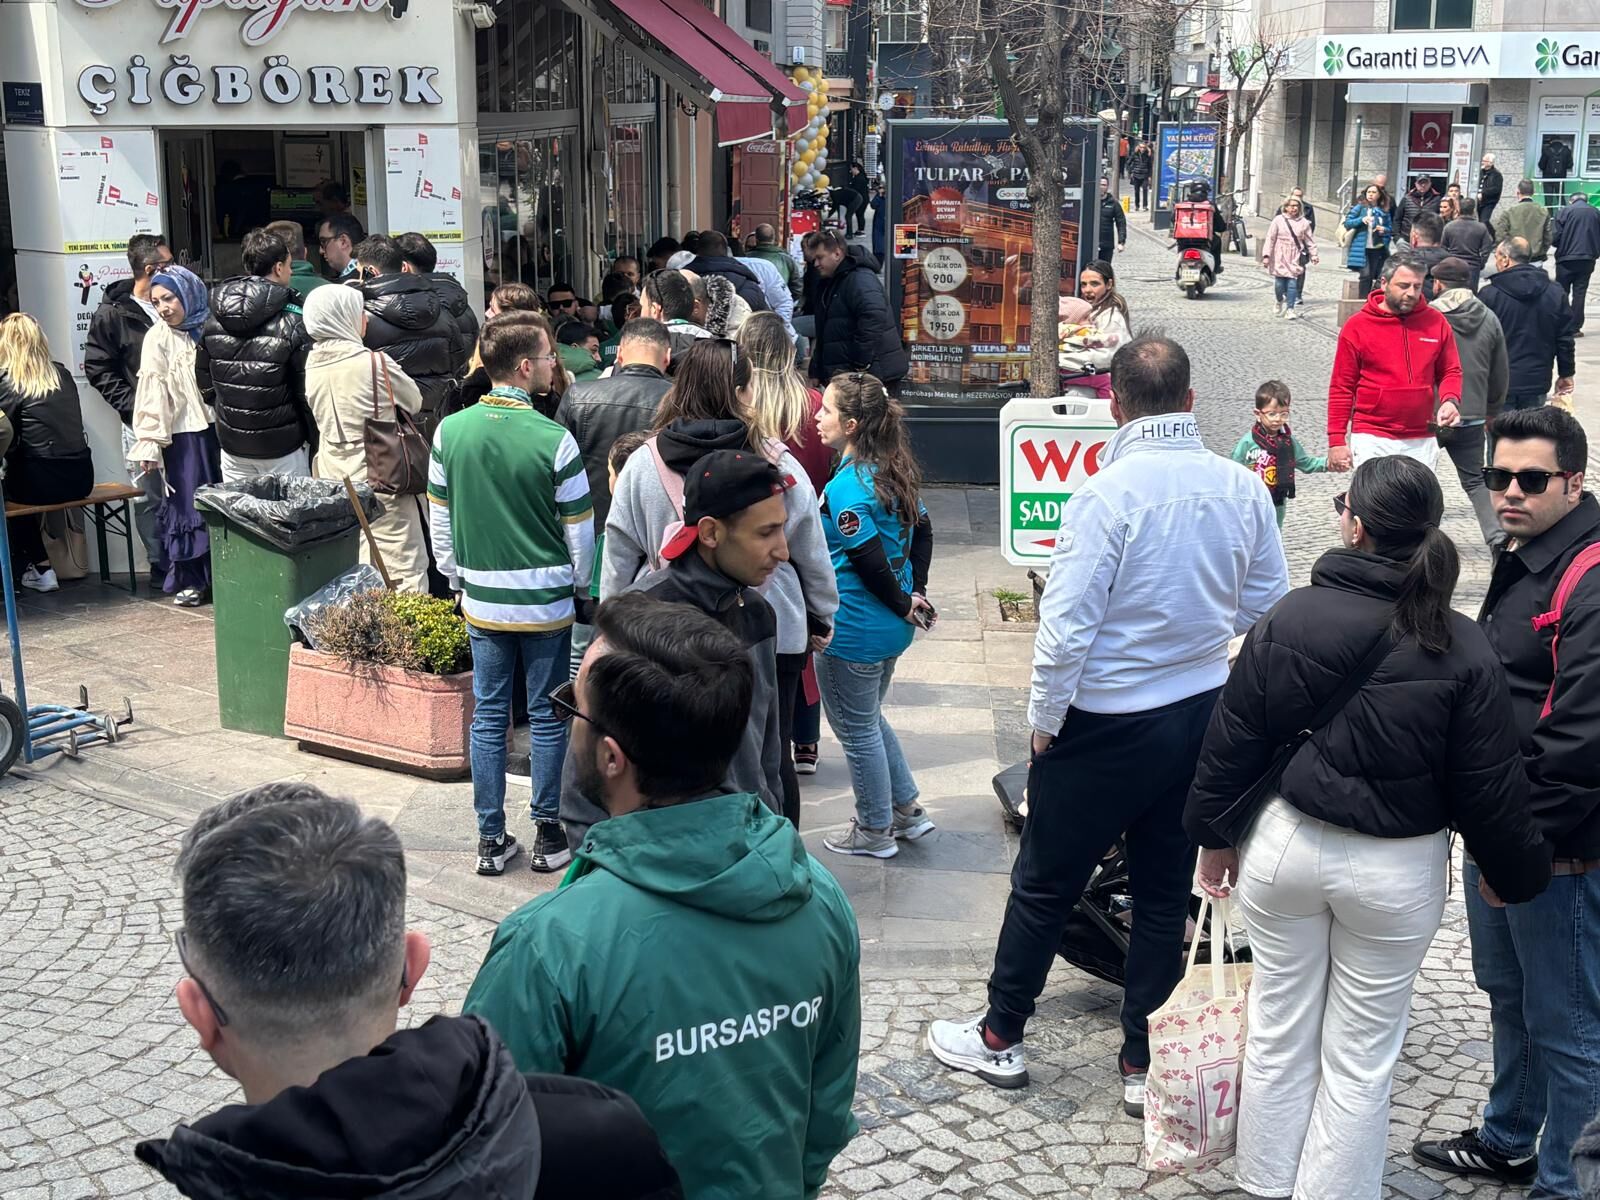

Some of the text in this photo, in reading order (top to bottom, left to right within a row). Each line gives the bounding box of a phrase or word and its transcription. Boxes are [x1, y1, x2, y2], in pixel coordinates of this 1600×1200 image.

[1347, 45, 1490, 67] Garanti BBVA
[78, 55, 443, 114] ÇİĞBÖREK
[915, 167, 984, 182] TULPAR
[911, 344, 947, 353] ŞİRKETLER
[1019, 500, 1063, 527] ŞAD
[656, 995, 823, 1063] BURSASPOR
